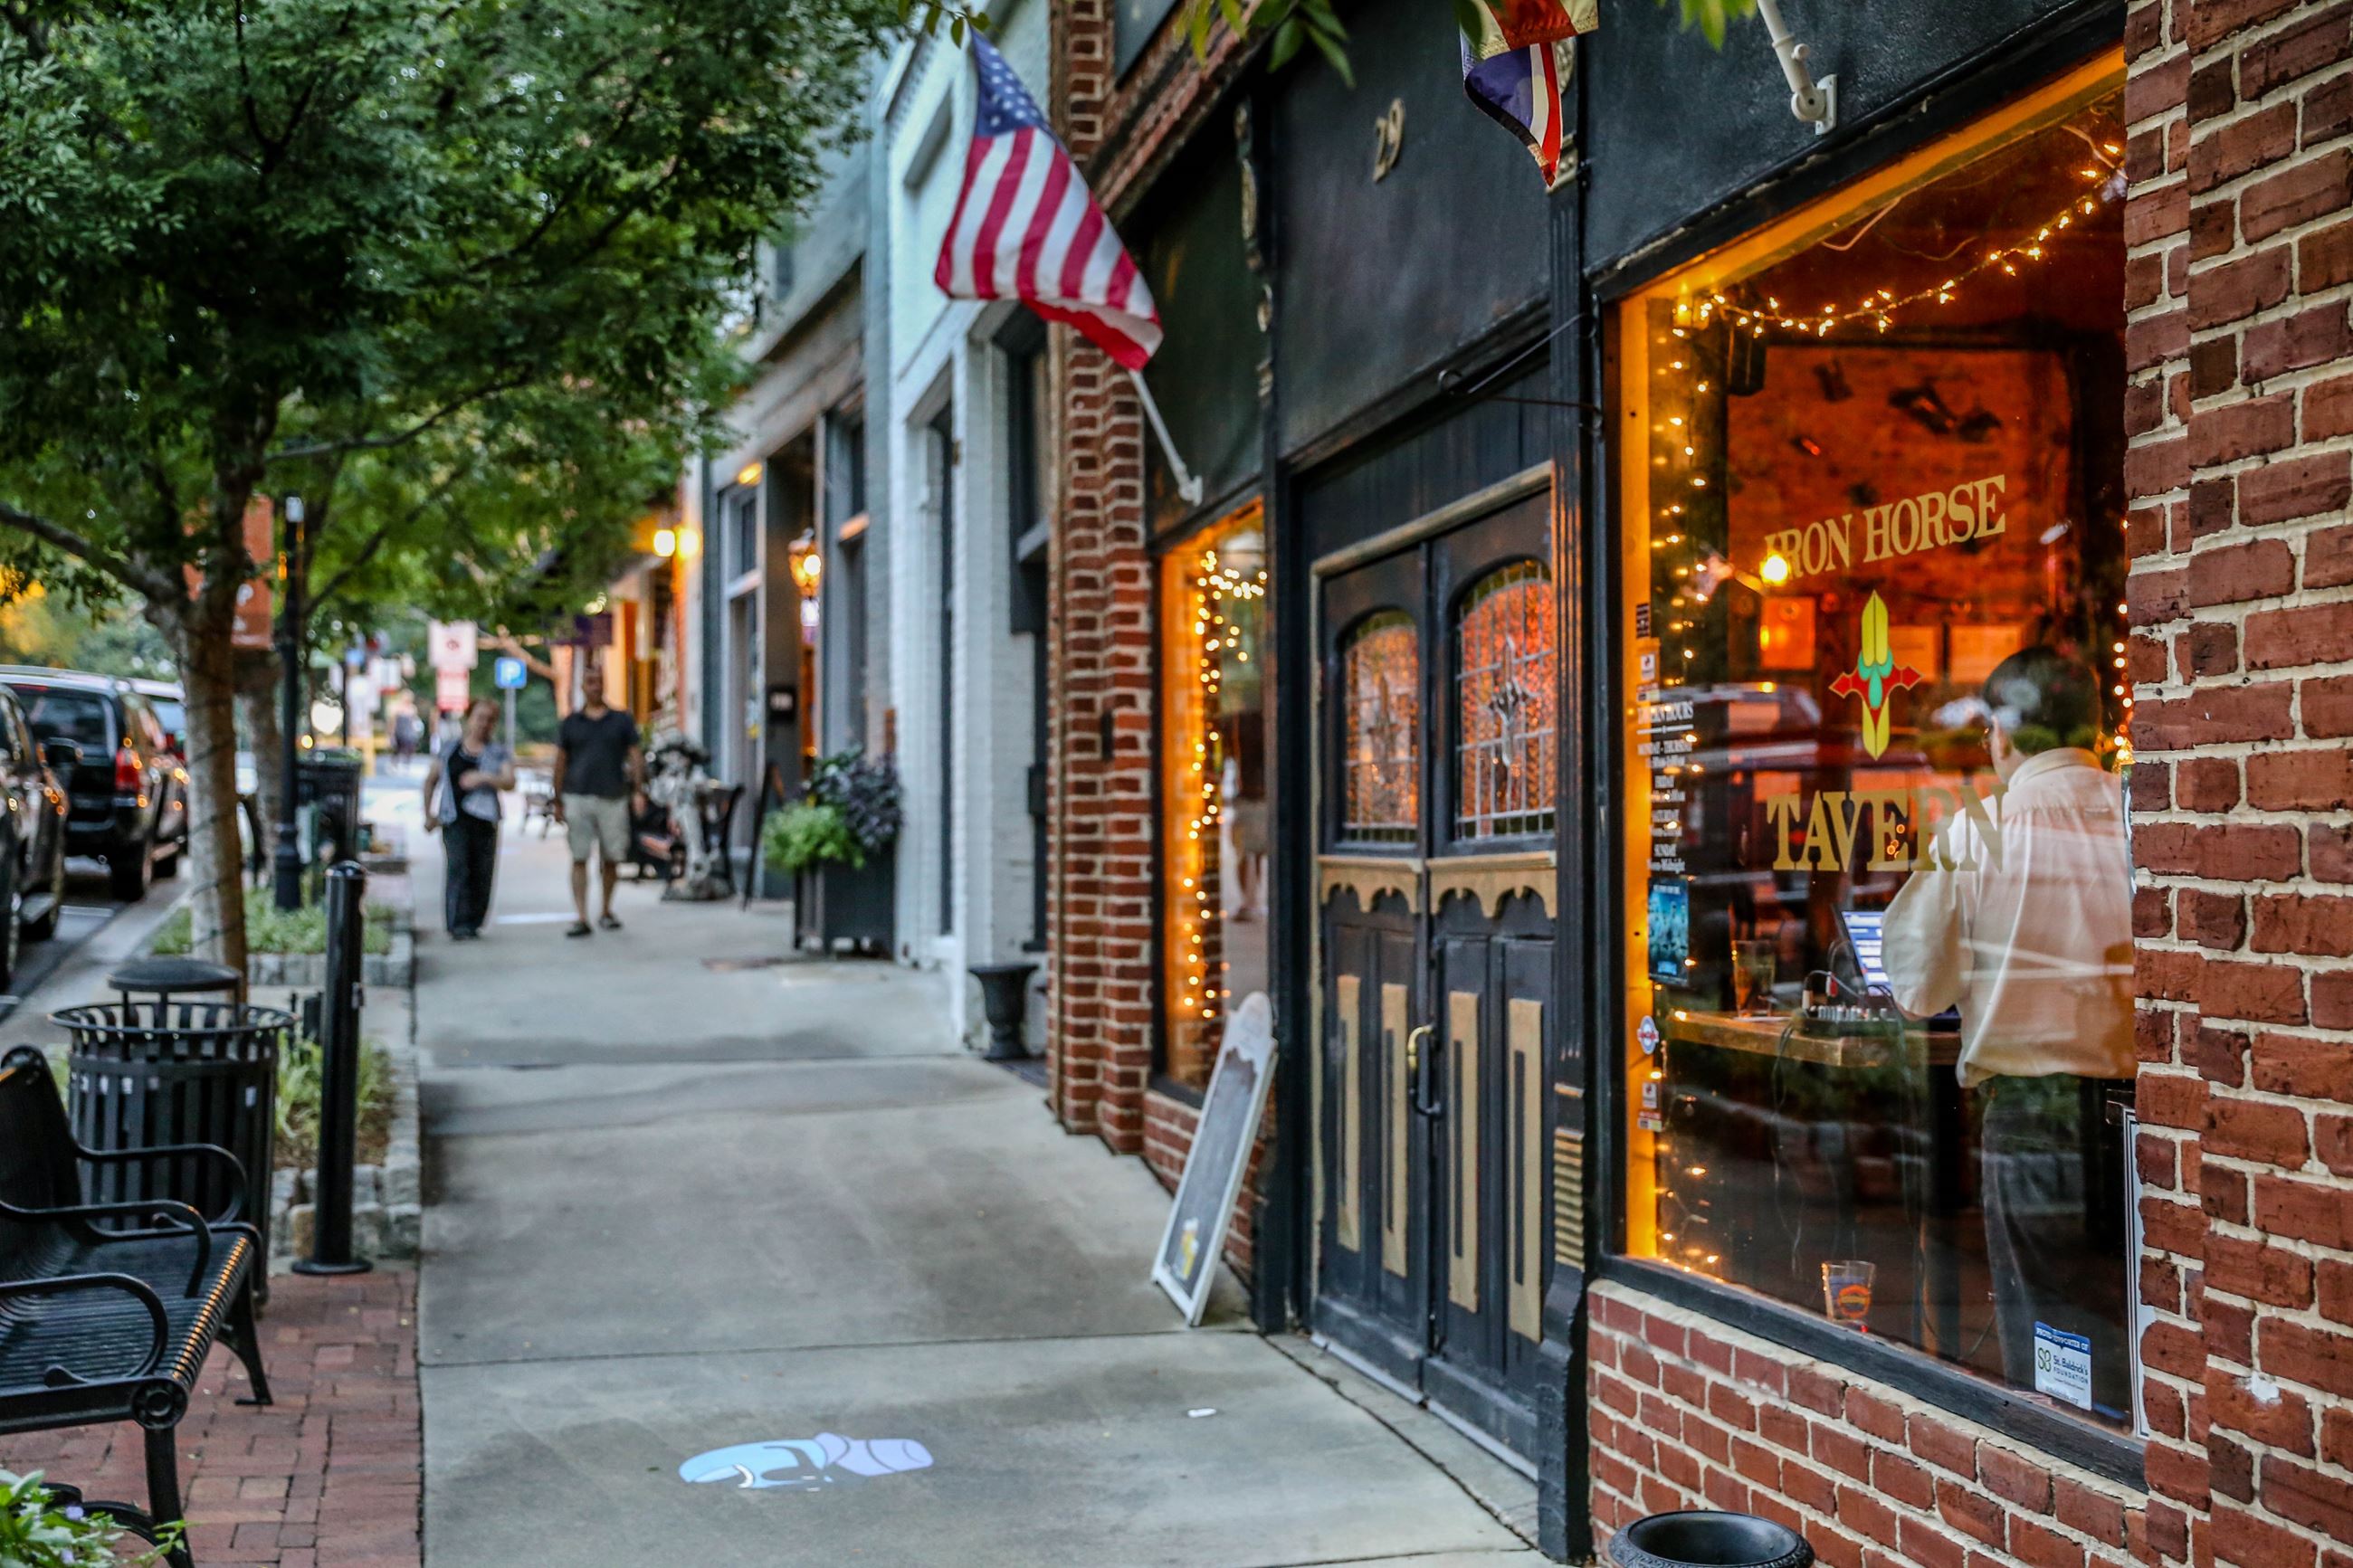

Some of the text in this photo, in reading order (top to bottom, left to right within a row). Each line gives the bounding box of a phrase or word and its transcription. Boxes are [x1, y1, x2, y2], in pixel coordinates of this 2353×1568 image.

[1863, 474, 2006, 563] HORSE
[500, 661, 521, 686] P
[1767, 785, 2008, 872] TAVERN
[2053, 1366, 2089, 1384] FOUNDATION
